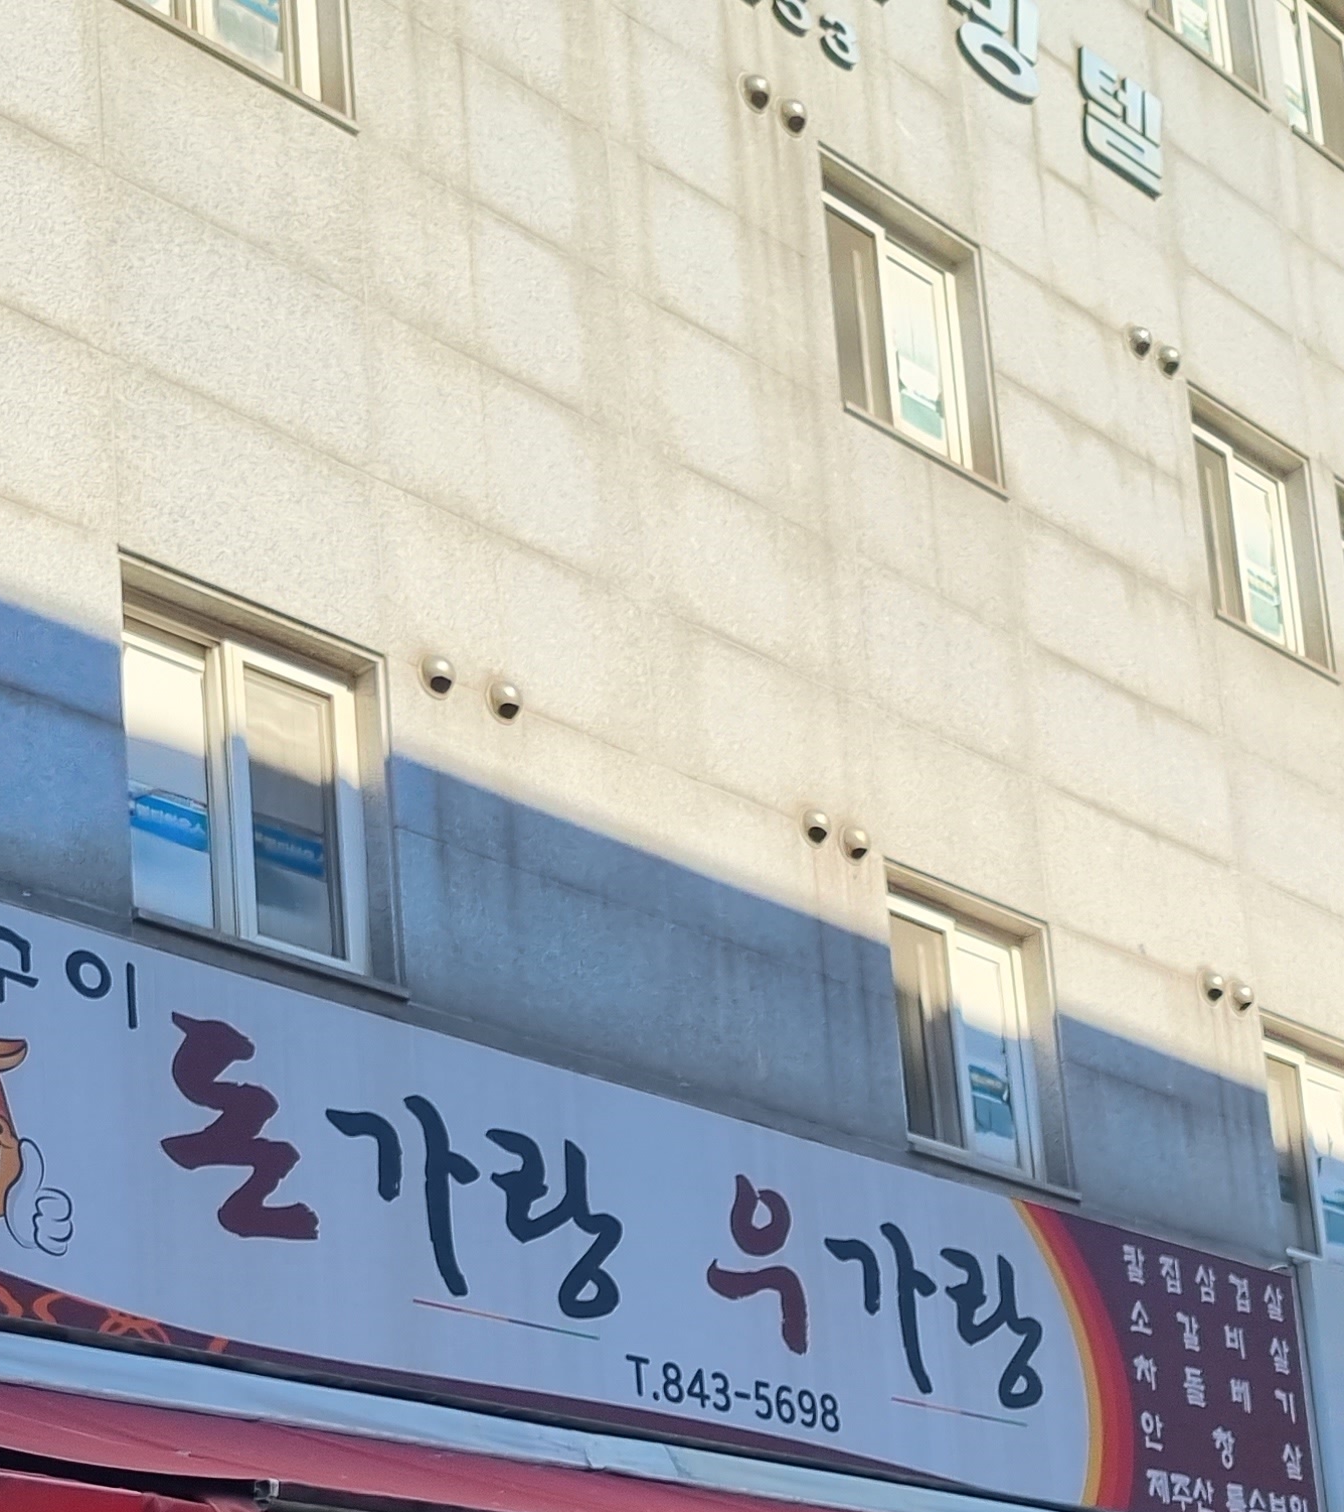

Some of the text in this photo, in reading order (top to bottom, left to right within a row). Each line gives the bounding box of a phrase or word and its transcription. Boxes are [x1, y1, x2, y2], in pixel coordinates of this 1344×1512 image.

[706, 1173, 1044, 1410] 우가랑
[1130, 1300, 1291, 1376] 소갈비살
[625, 1353, 842, 1435] T.843-5698
[1140, 1410, 1304, 1481] 안창살
